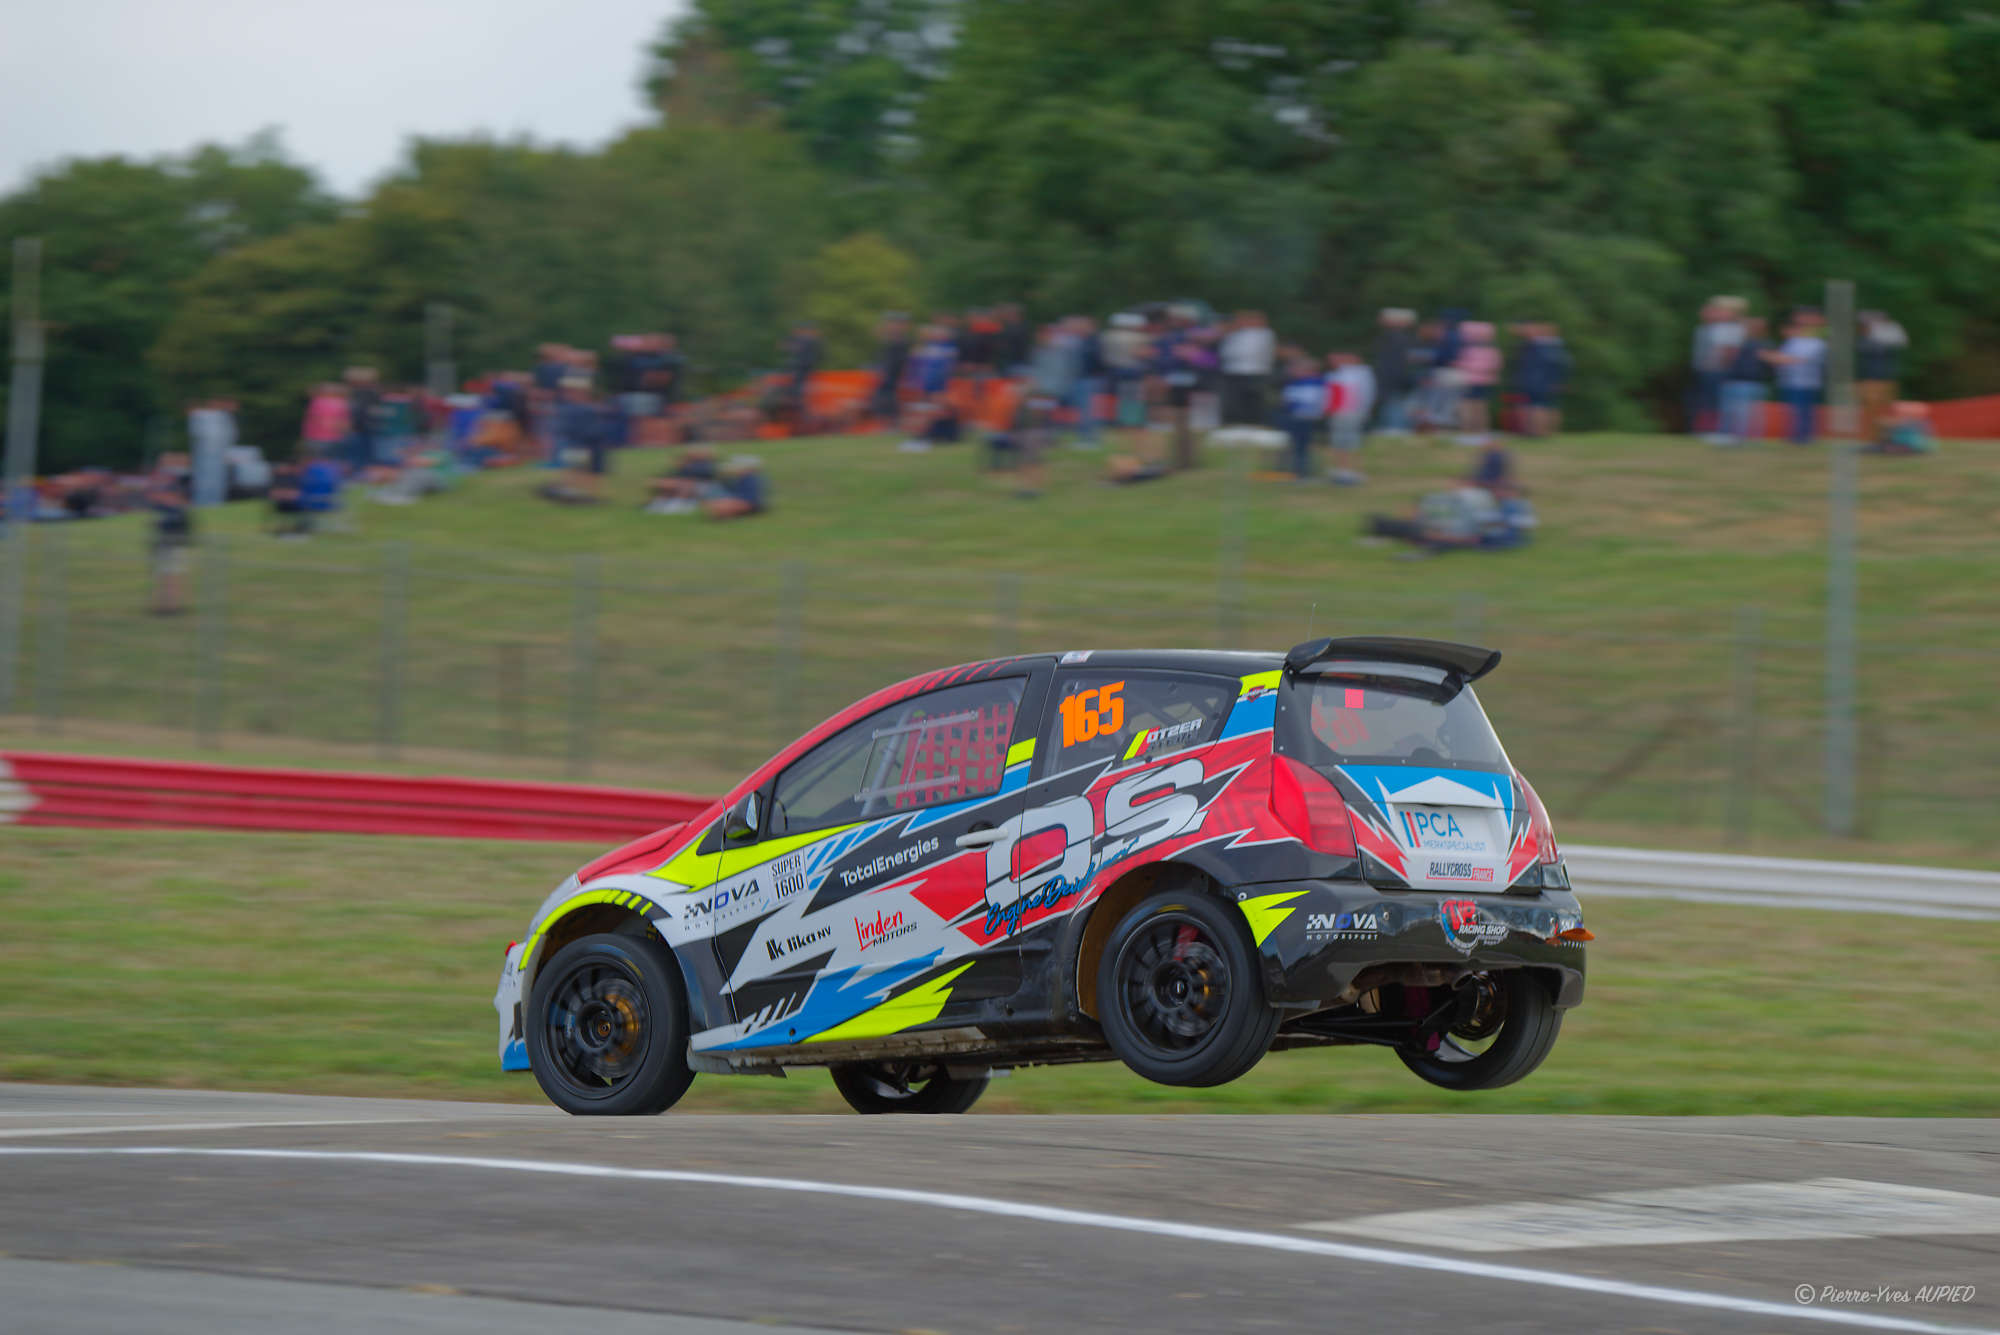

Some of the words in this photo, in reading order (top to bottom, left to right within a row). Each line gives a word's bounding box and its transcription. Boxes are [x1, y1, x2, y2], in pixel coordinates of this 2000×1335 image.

[1059, 680, 1125, 748] 165
[1415, 812, 1464, 838] PCA
[771, 854, 802, 877] SUPER
[840, 837, 940, 887] TotalEnergies
[1428, 861, 1473, 878] RALLYCROSS
[775, 873, 804, 900] 1600
[984, 892, 1045, 936] Engine
[817, 925, 832, 940] NV
[855, 909, 904, 952] Linden
[872, 921, 918, 948] MOTORS
[1306, 933, 1378, 941] MOTORSPORT
[1458, 924, 1486, 936] RACING
[1486, 925, 1507, 937] SHOP
